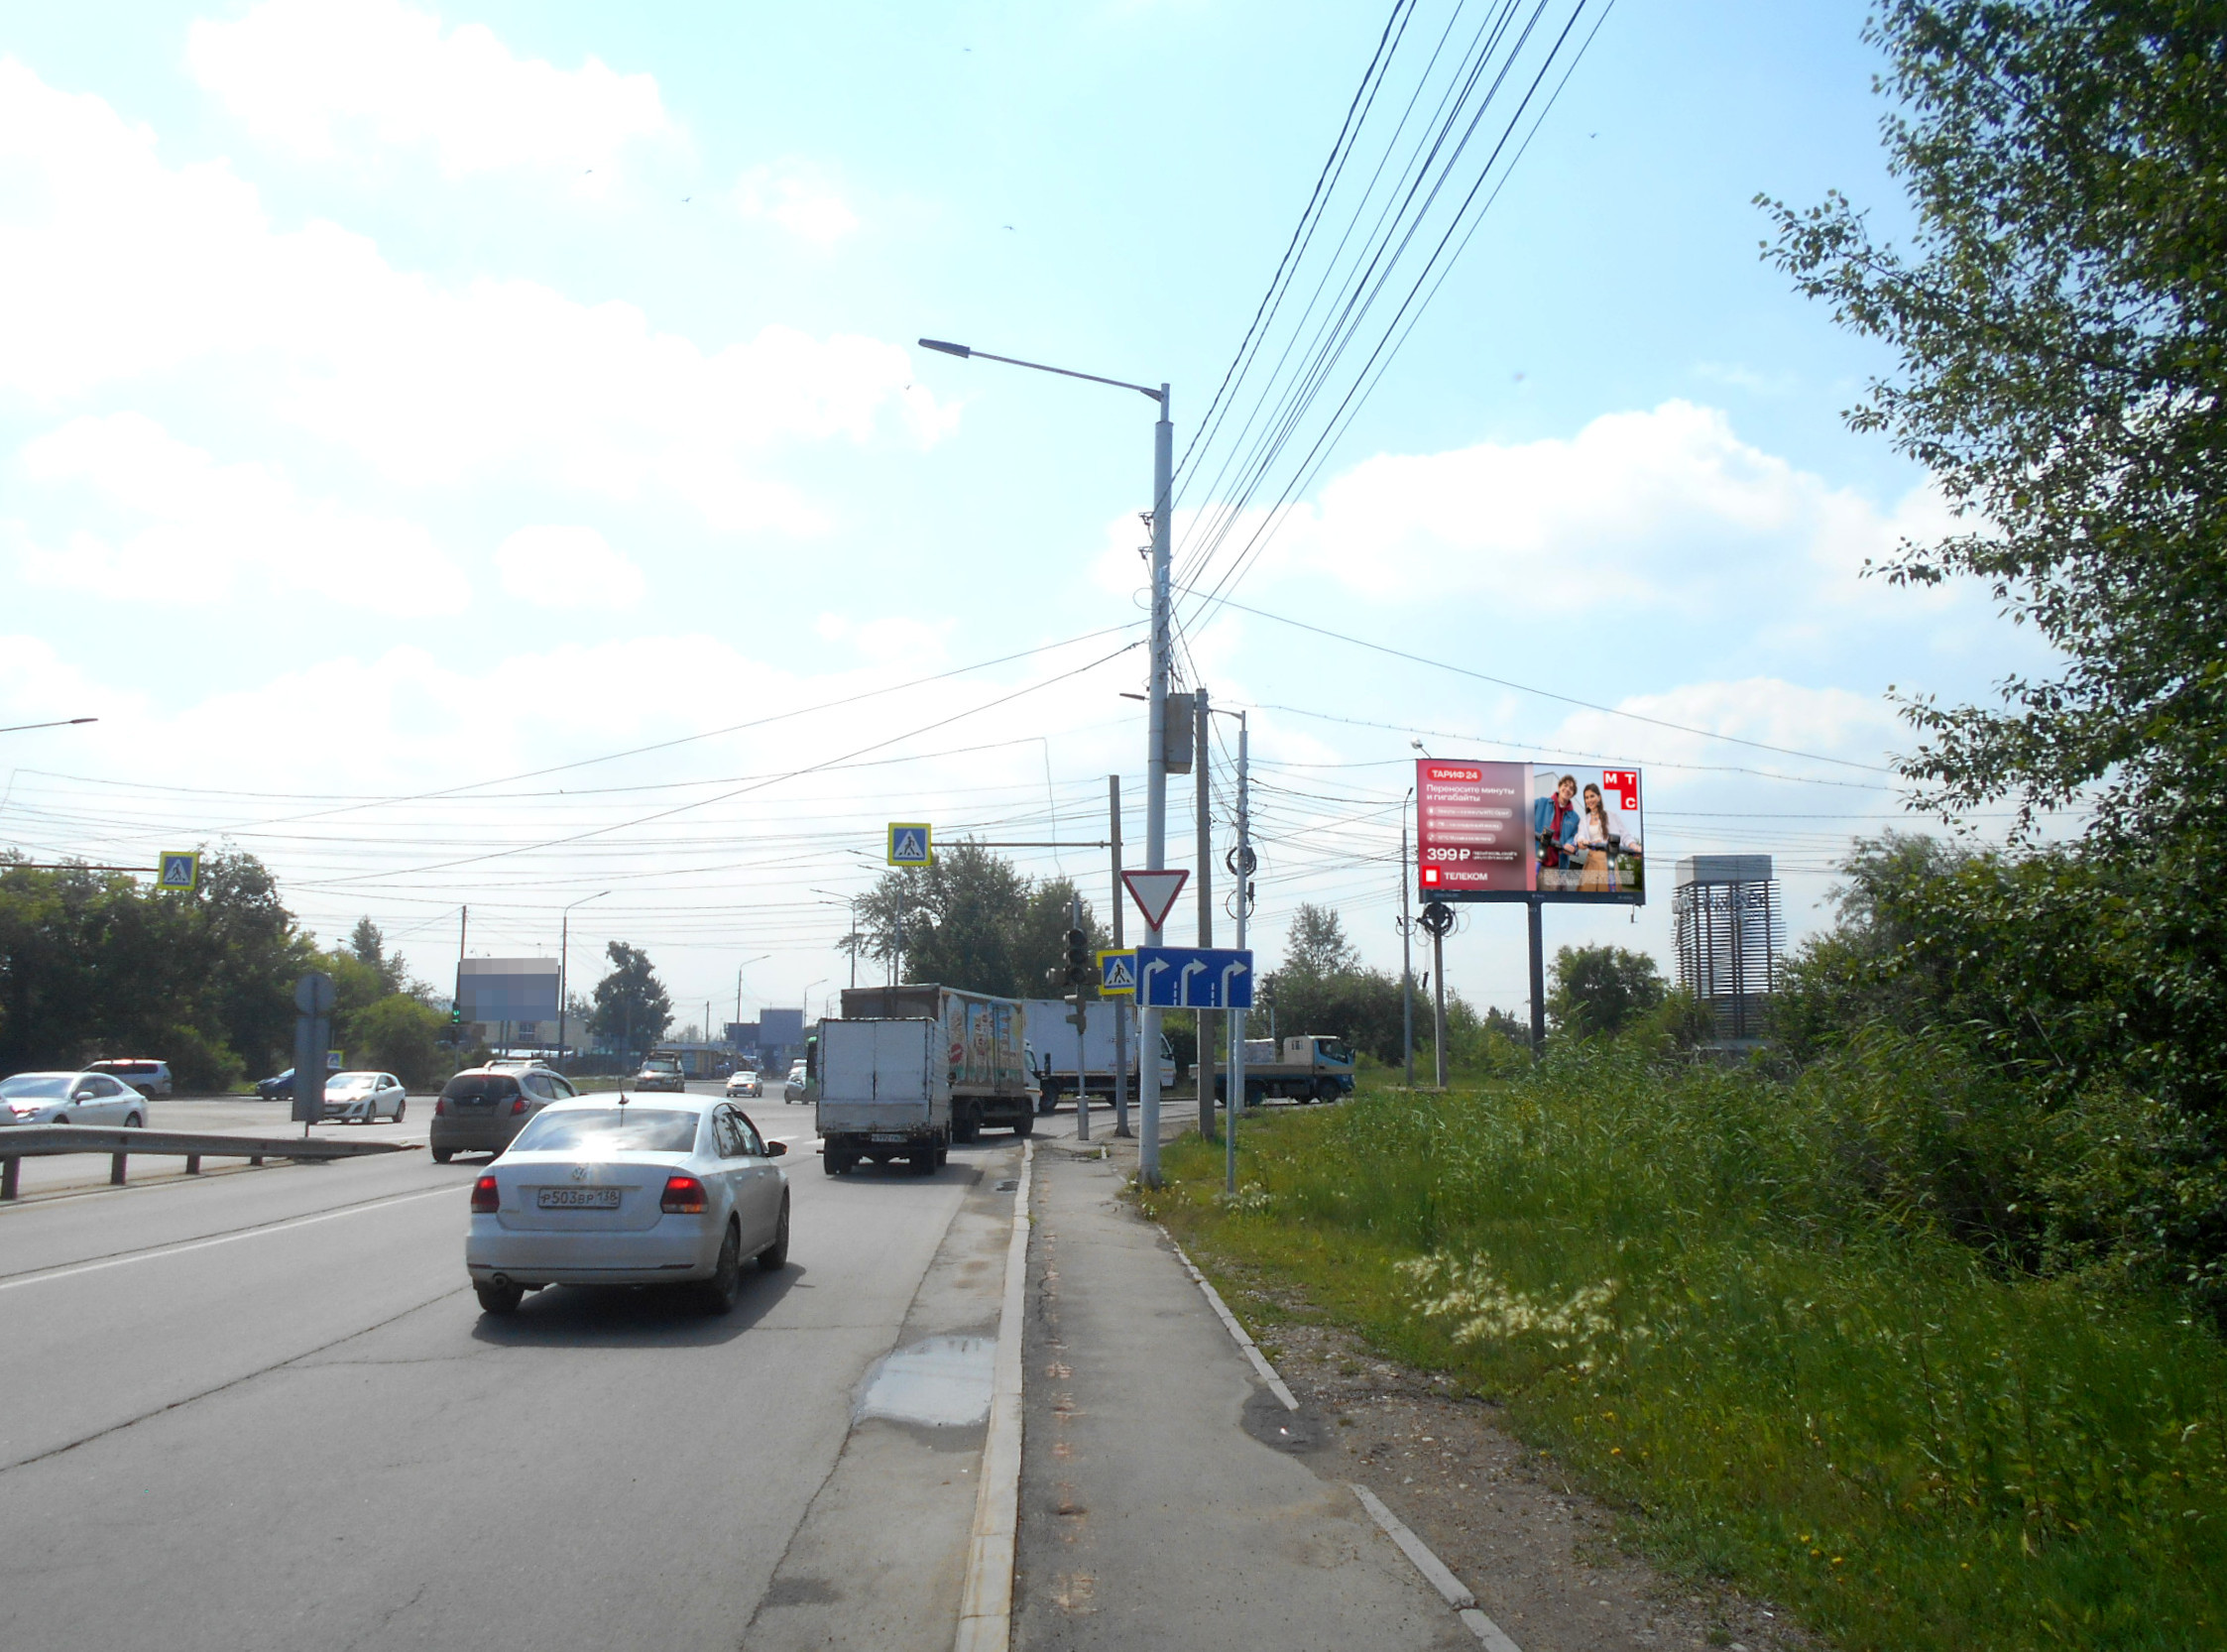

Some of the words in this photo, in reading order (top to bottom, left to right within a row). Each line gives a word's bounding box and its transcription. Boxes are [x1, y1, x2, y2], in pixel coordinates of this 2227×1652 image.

[1432, 769, 1465, 779] ТАРИФ
[1427, 783, 1480, 794] Переносите
[1481, 787, 1515, 796] минуты
[1605, 772, 1636, 808] МТС
[1427, 848, 1458, 861] 399
[1444, 872, 1488, 881] ТЕЛЕКОМ
